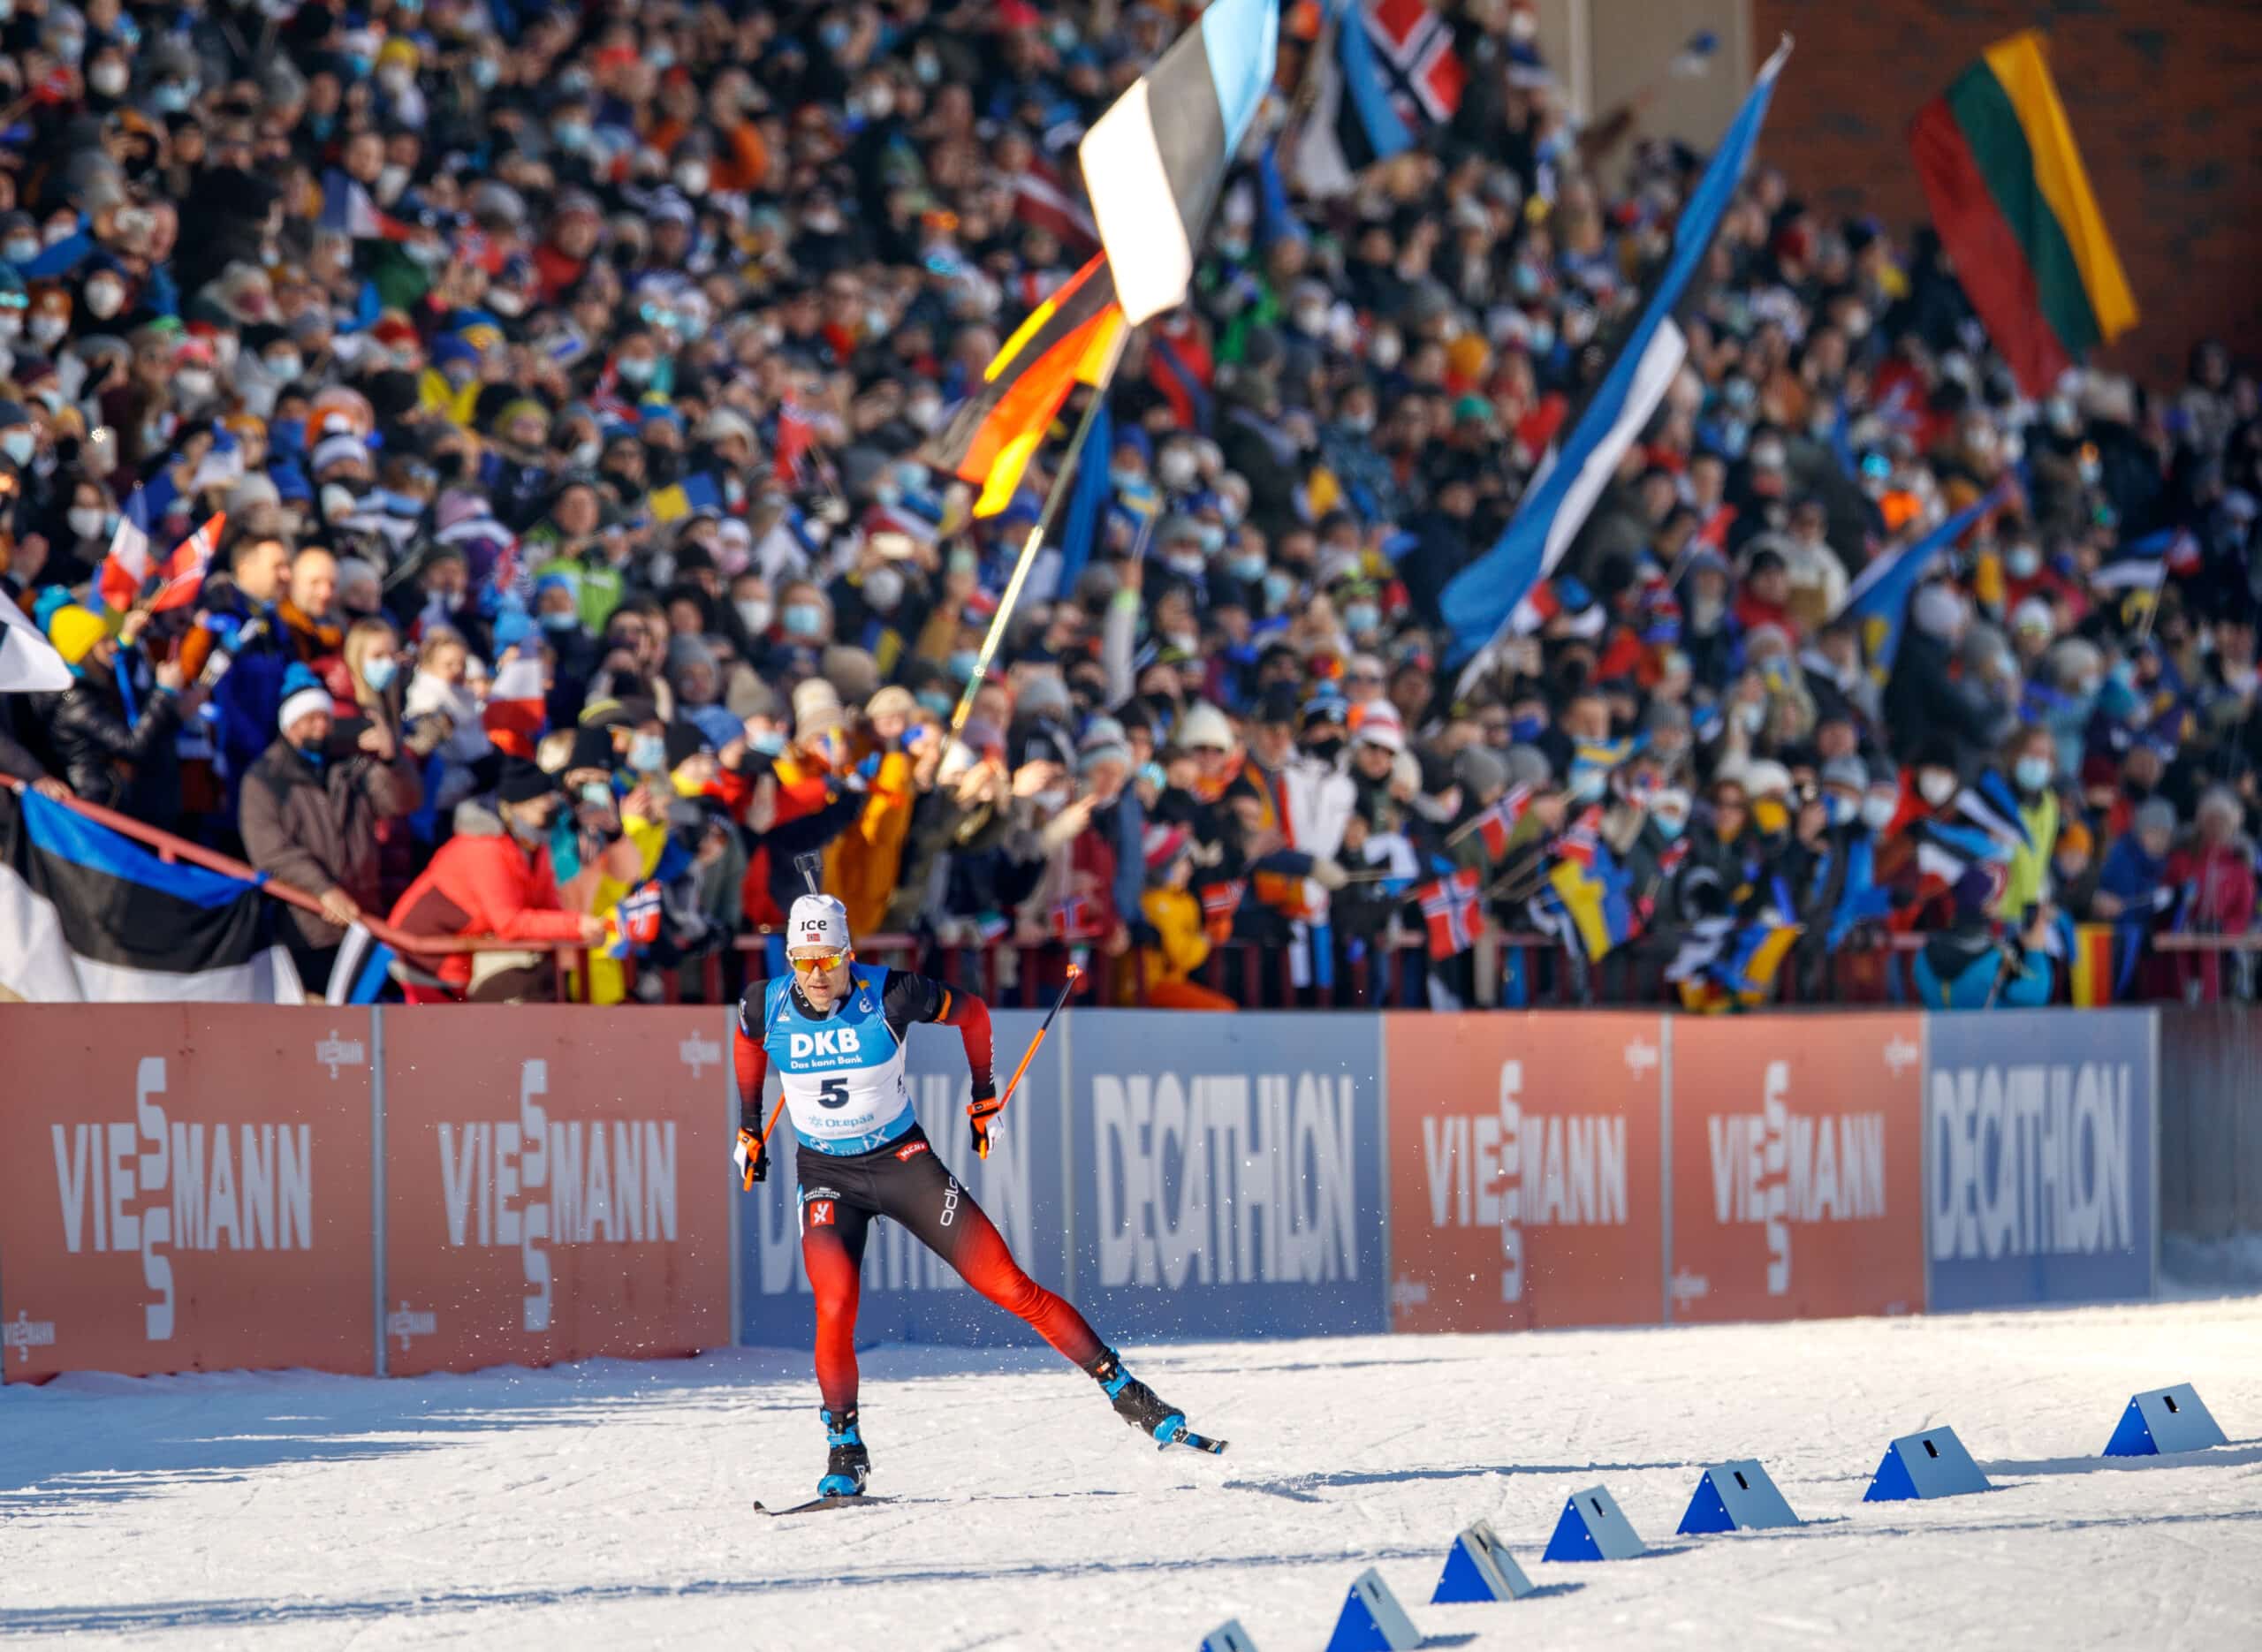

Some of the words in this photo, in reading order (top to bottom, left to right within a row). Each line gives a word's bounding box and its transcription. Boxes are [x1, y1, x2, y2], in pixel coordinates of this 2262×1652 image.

[790, 1027, 861, 1058] DKB
[812, 1059, 836, 1068] kann
[838, 1056, 862, 1065] Bank
[817, 1077, 850, 1110] 5
[1932, 1061, 2133, 1261] DECATHLON
[1092, 1070, 1358, 1290] DECATHLON
